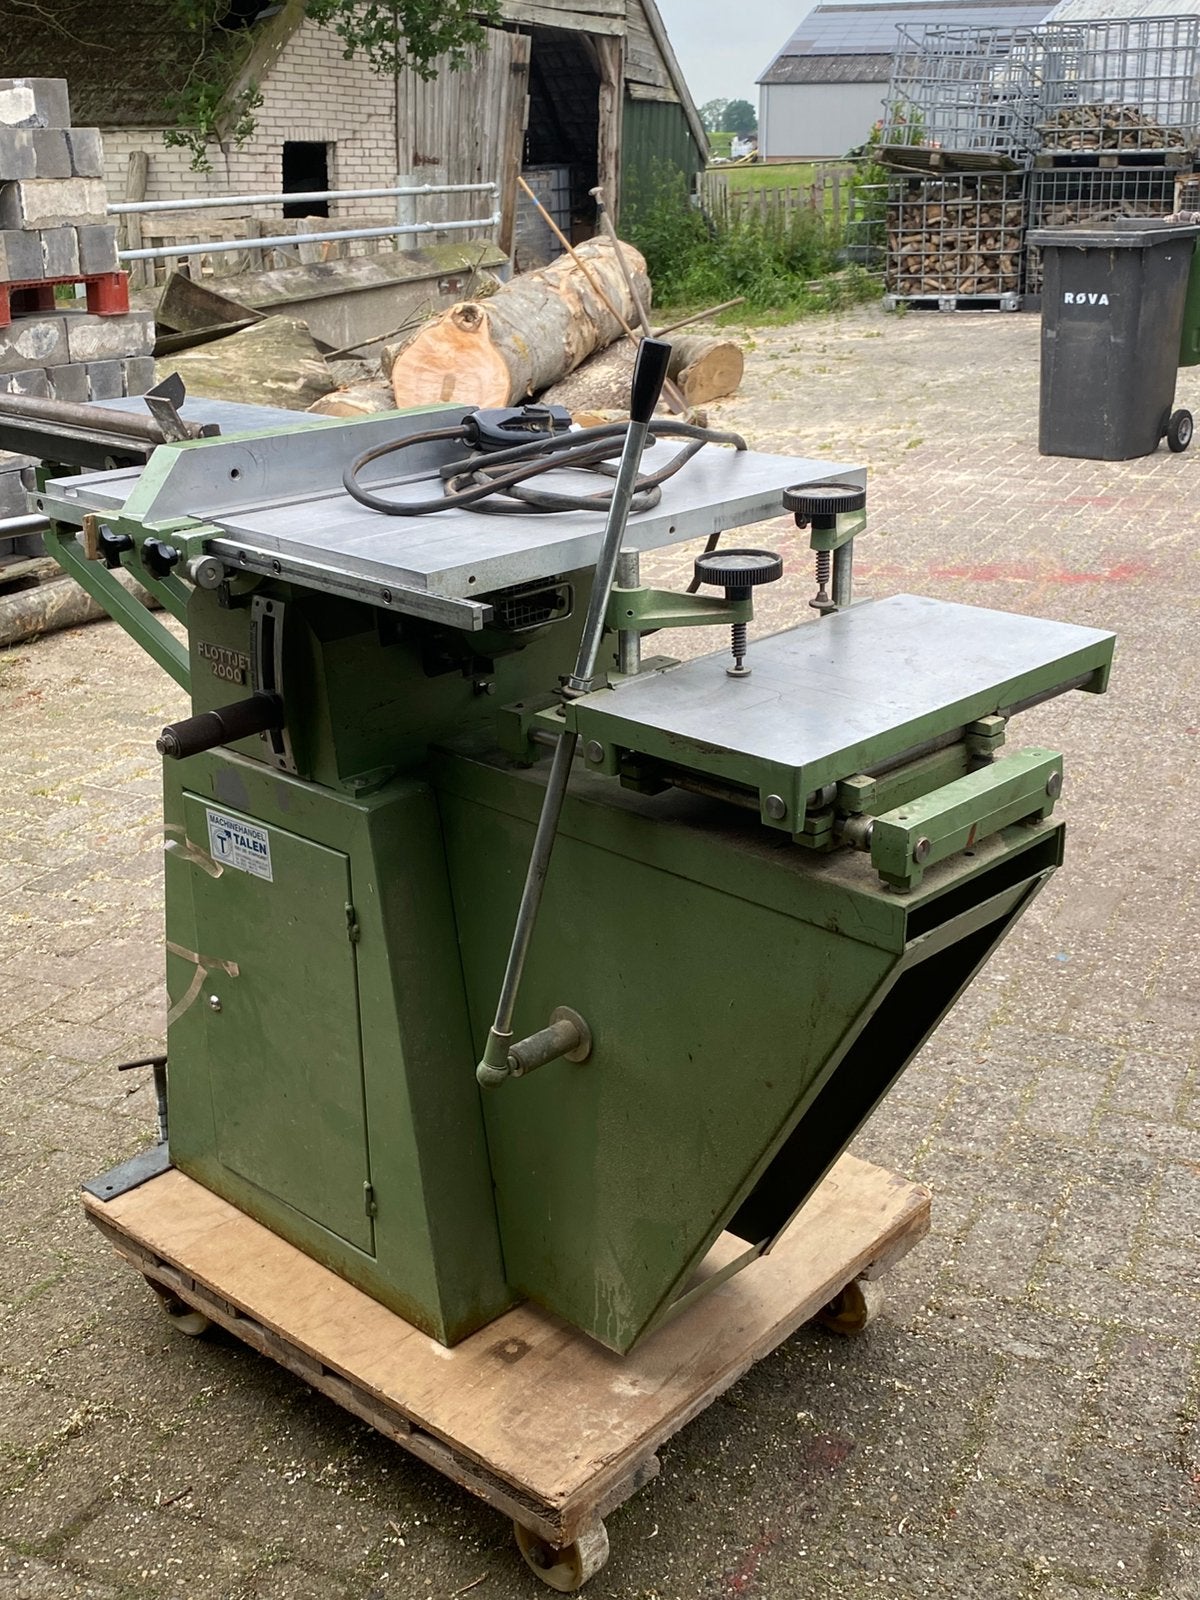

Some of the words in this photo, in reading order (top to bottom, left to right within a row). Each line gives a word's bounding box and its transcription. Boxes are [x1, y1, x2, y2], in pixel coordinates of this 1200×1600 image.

[211, 661, 242, 683] 2000
[209, 814, 266, 842] MACHINEHANDEL
[233, 832, 267, 856] TALEN
